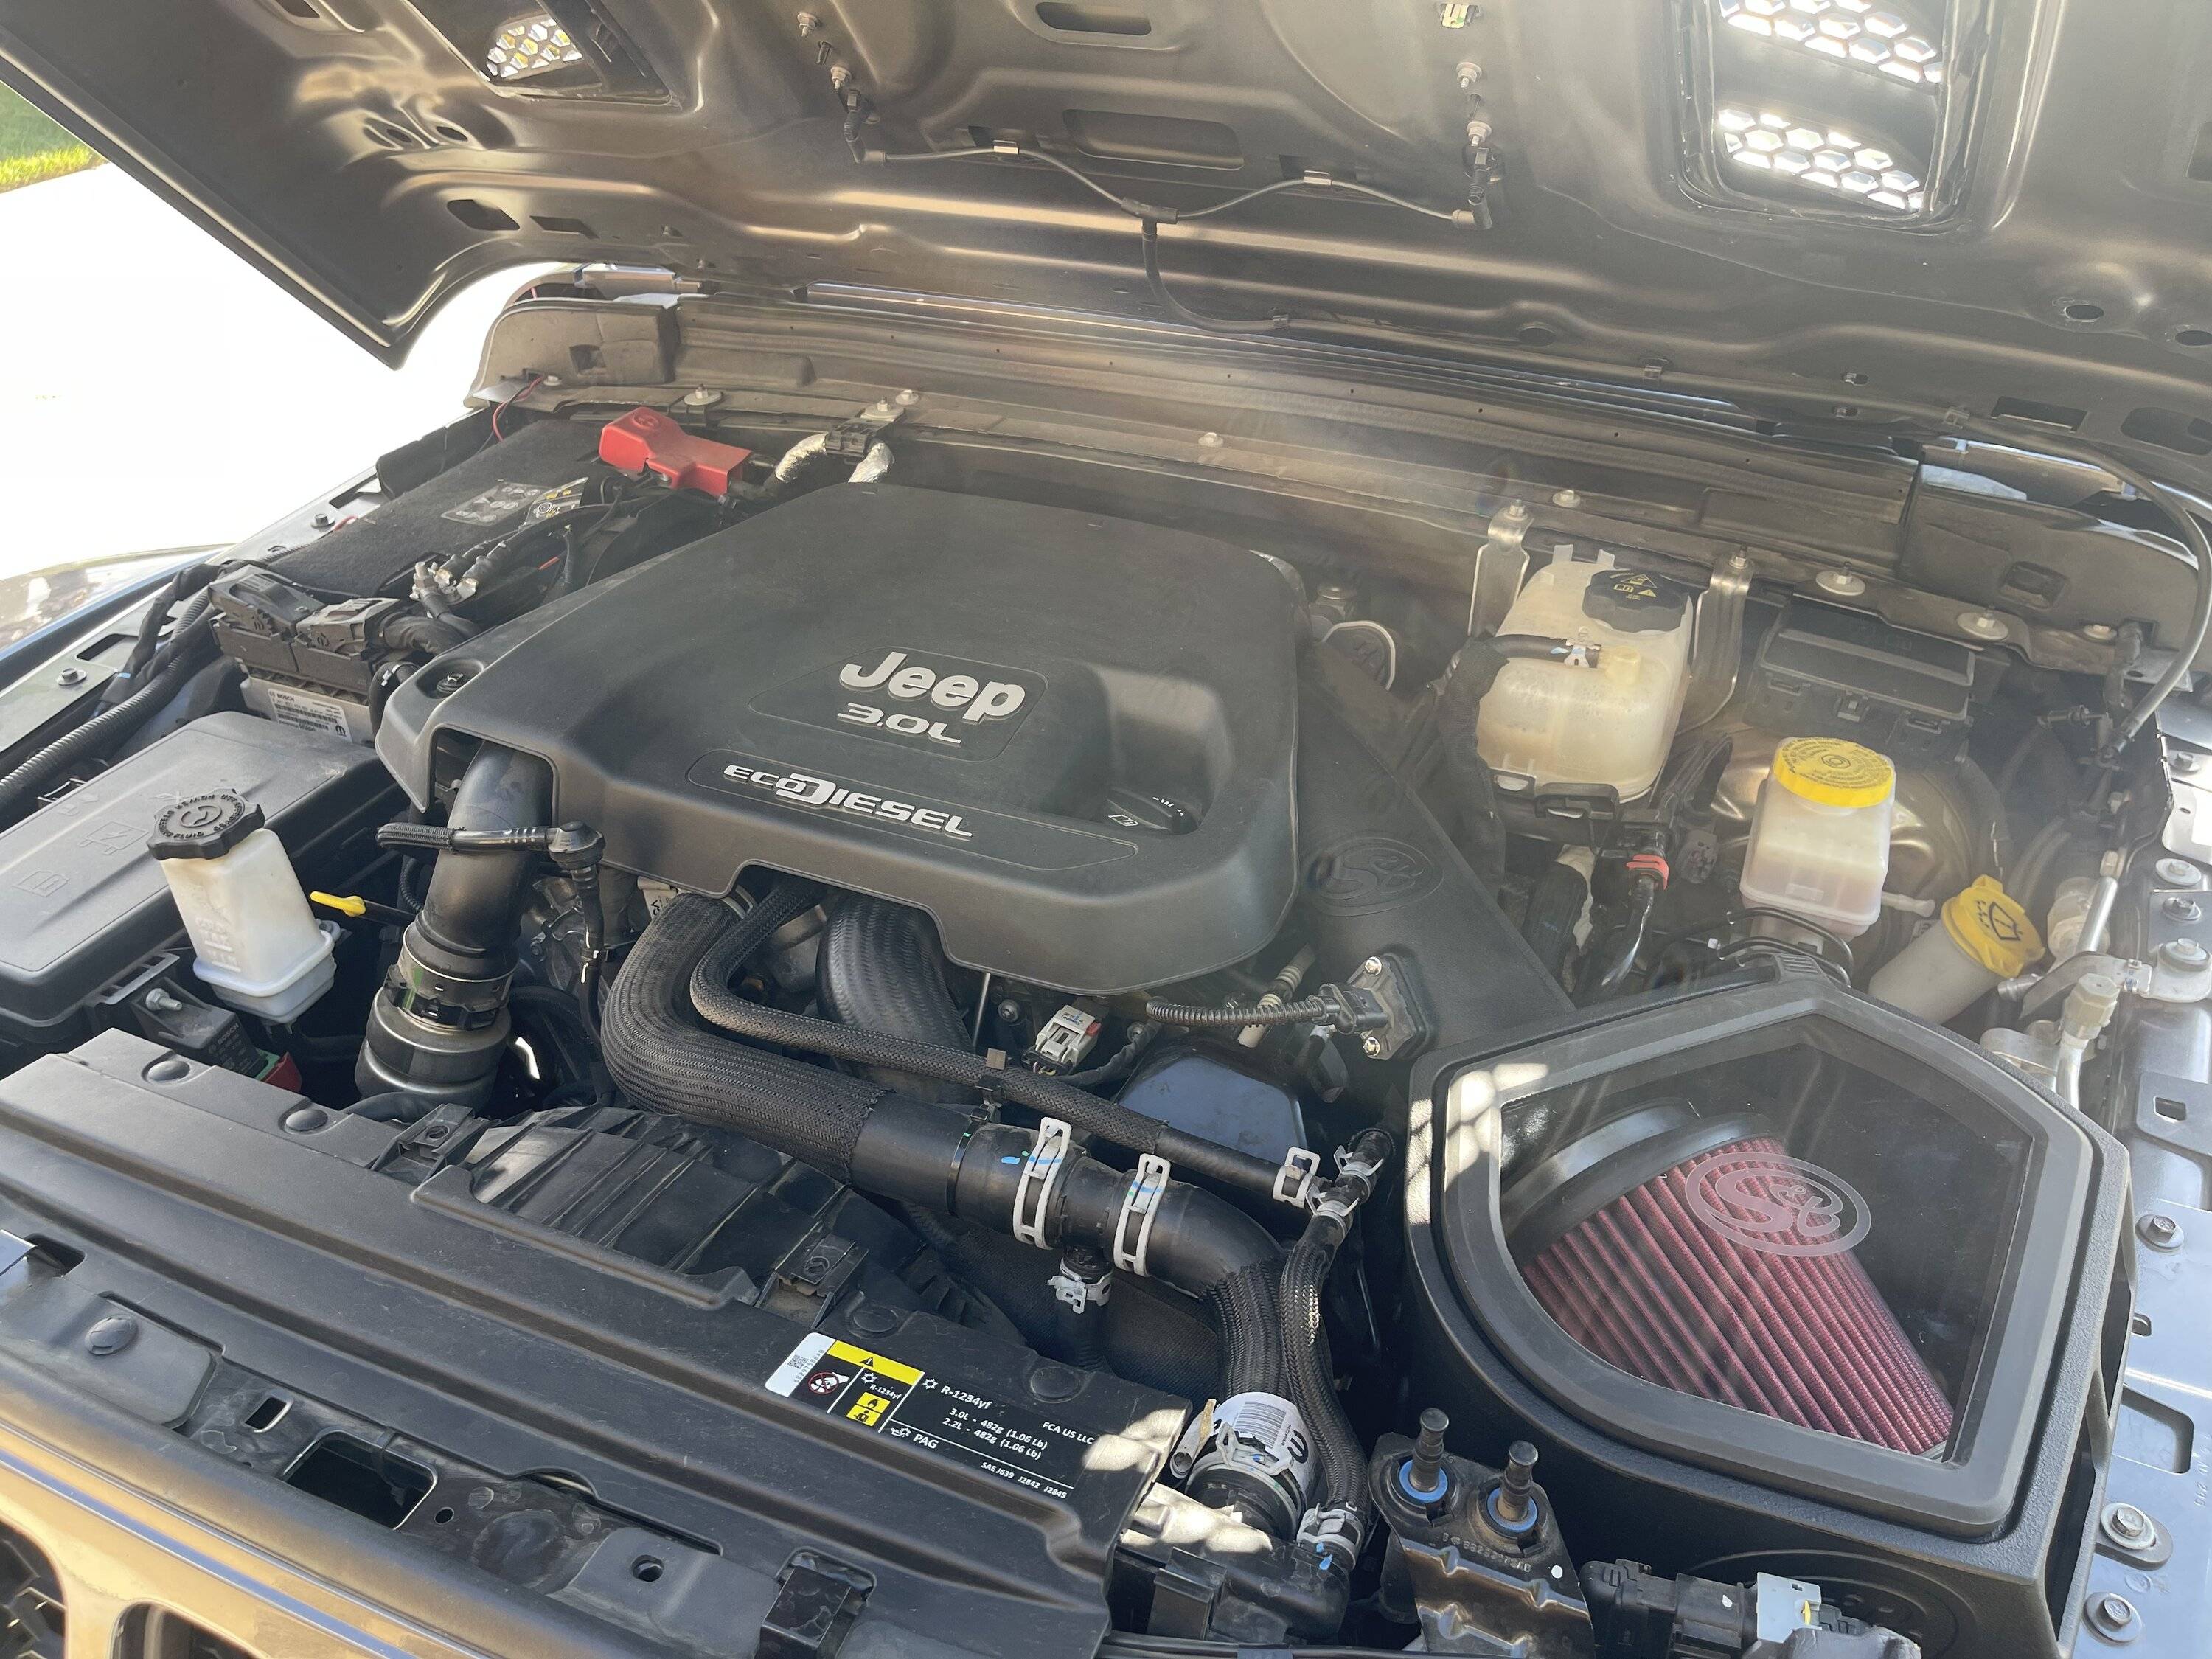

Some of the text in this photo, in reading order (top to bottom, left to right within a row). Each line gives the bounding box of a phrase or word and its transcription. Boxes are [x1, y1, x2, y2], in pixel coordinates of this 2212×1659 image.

[839, 652, 1026, 724] Jeep
[837, 703, 962, 746] 3.0L
[869, 1384, 903, 1400] R-1234yf
[941, 1385, 993, 1409] R-1234yf
[913, 1433, 939, 1450] PAG
[942, 1417, 963, 1430] 2.2L
[973, 1429, 998, 1445] 482g
[1000, 1438, 1026, 1453] (1.06
[1025, 1447, 1043, 1461] Lb)
[949, 1408, 970, 1421] 3.0L
[980, 1419, 1004, 1435] 482g
[1006, 1428, 1032, 1442] (1.06
[1032, 1437, 1048, 1450] Lb)
[1042, 1421, 1096, 1445] FCA US LLC
[981, 1461, 1068, 1500] SAE J639 J2842 J2845
